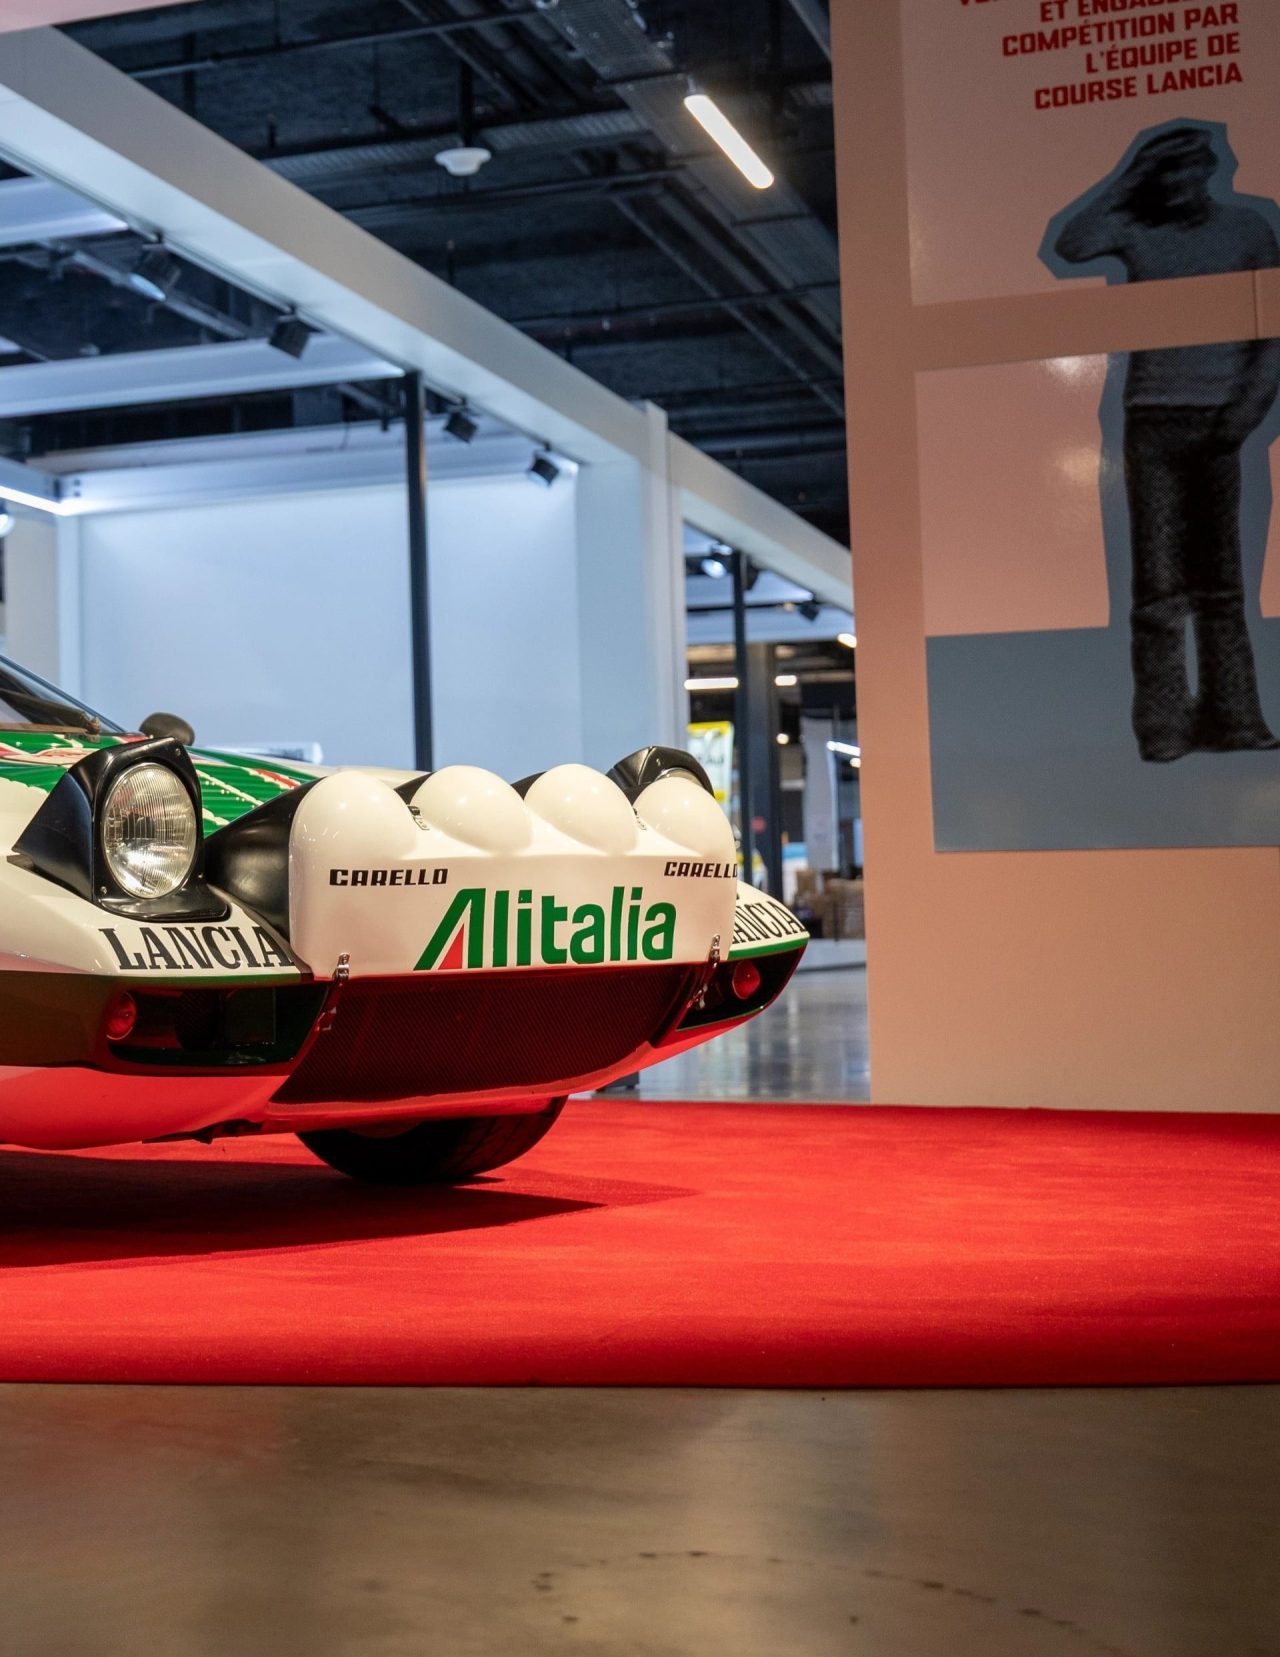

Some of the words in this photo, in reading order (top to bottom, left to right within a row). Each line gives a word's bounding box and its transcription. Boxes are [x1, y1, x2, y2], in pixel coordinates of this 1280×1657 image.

[1002, 12, 1175, 56] COMPÉTITION
[1184, 3, 1238, 30] PAR
[1086, 38, 1198, 74] L'ÉQUIPE
[1207, 32, 1240, 58] DE
[1035, 76, 1137, 109] COURSE
[1147, 62, 1243, 95] LANCIA
[329, 868, 449, 886] CARELLO
[412, 886, 677, 971] Alitalia
[732, 901, 807, 944] ANCIA
[98, 926, 296, 970] LANCIA
